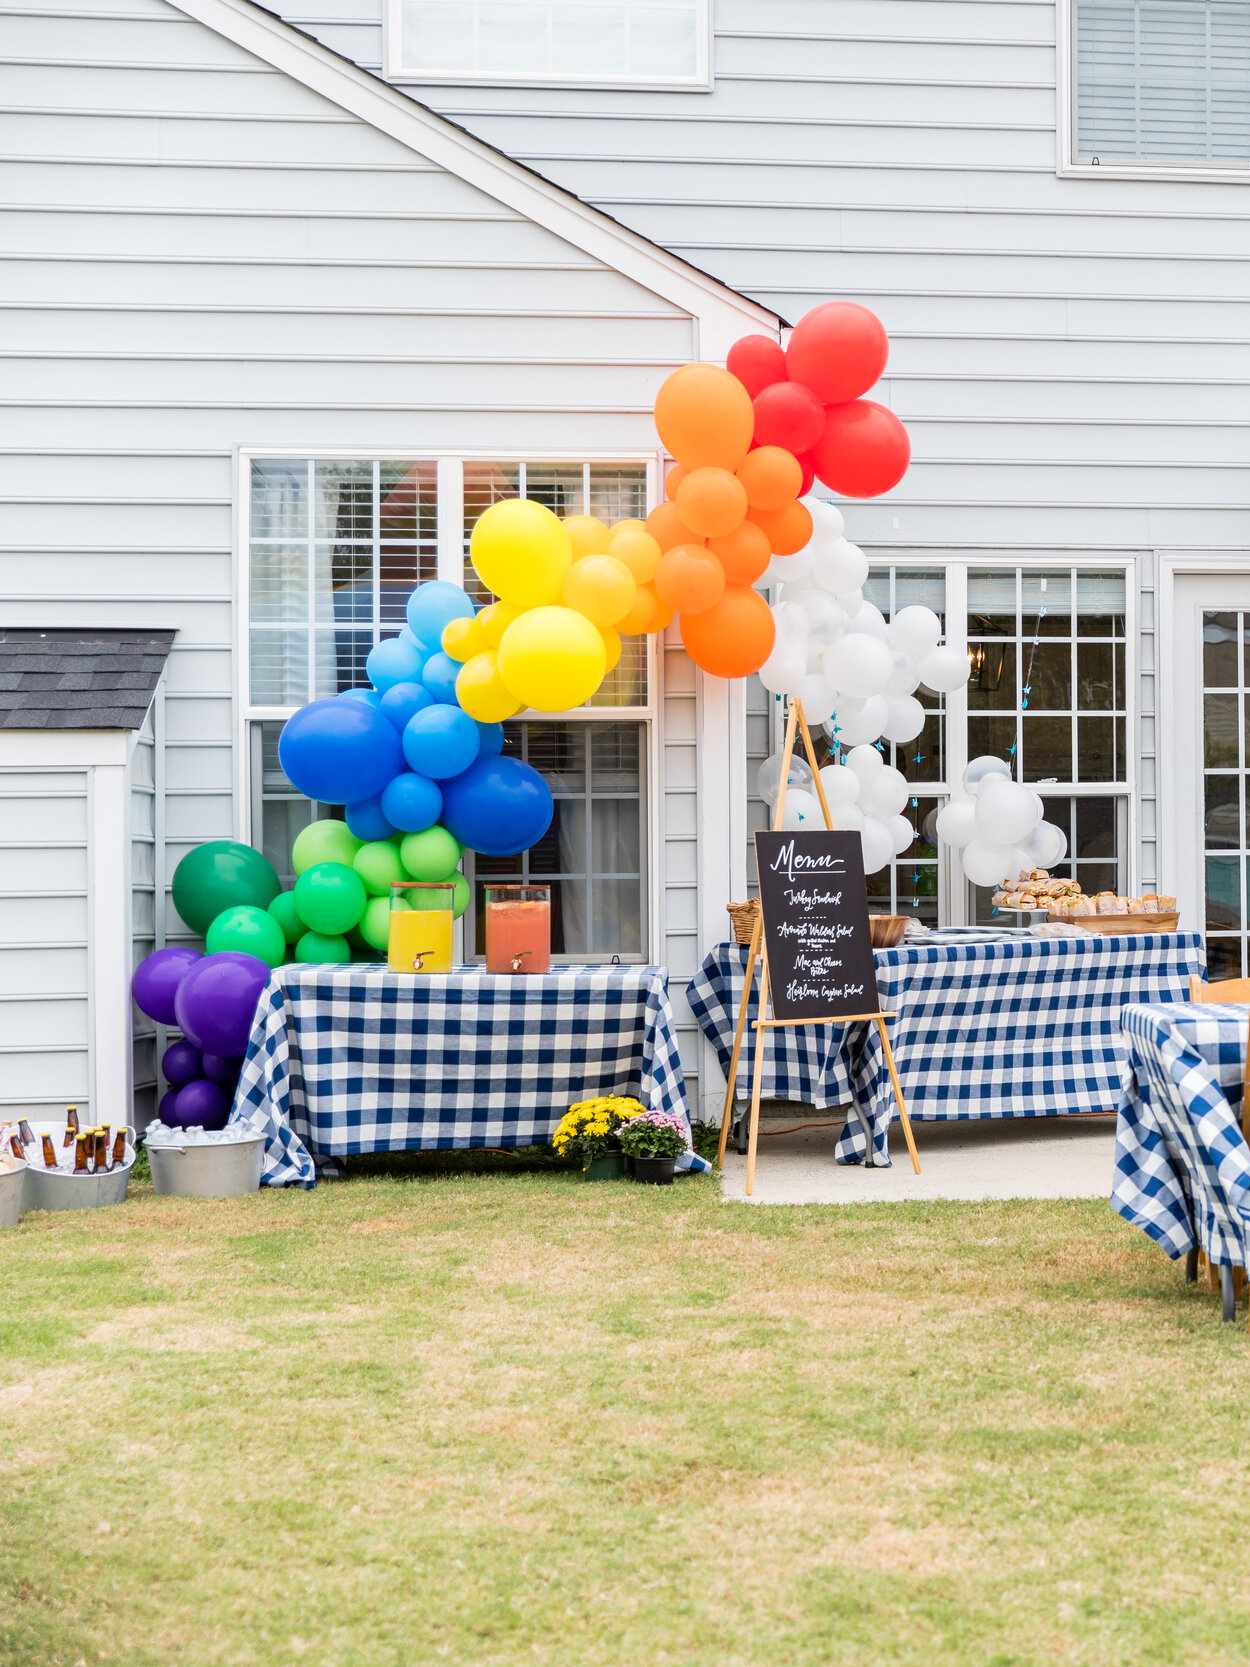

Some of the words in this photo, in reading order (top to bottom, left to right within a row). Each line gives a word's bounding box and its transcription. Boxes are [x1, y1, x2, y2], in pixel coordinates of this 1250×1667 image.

[770, 839, 845, 882] Menu
[784, 889, 814, 912] Turkey
[812, 888, 843, 906] Sandwich
[836, 924, 854, 939] Salad
[793, 954, 812, 971] Mac
[812, 957, 823, 967] and
[823, 956, 843, 967] Cheese
[811, 966, 829, 977] Bites
[786, 979, 819, 1002] Heirloom
[843, 984, 864, 998] Salad
